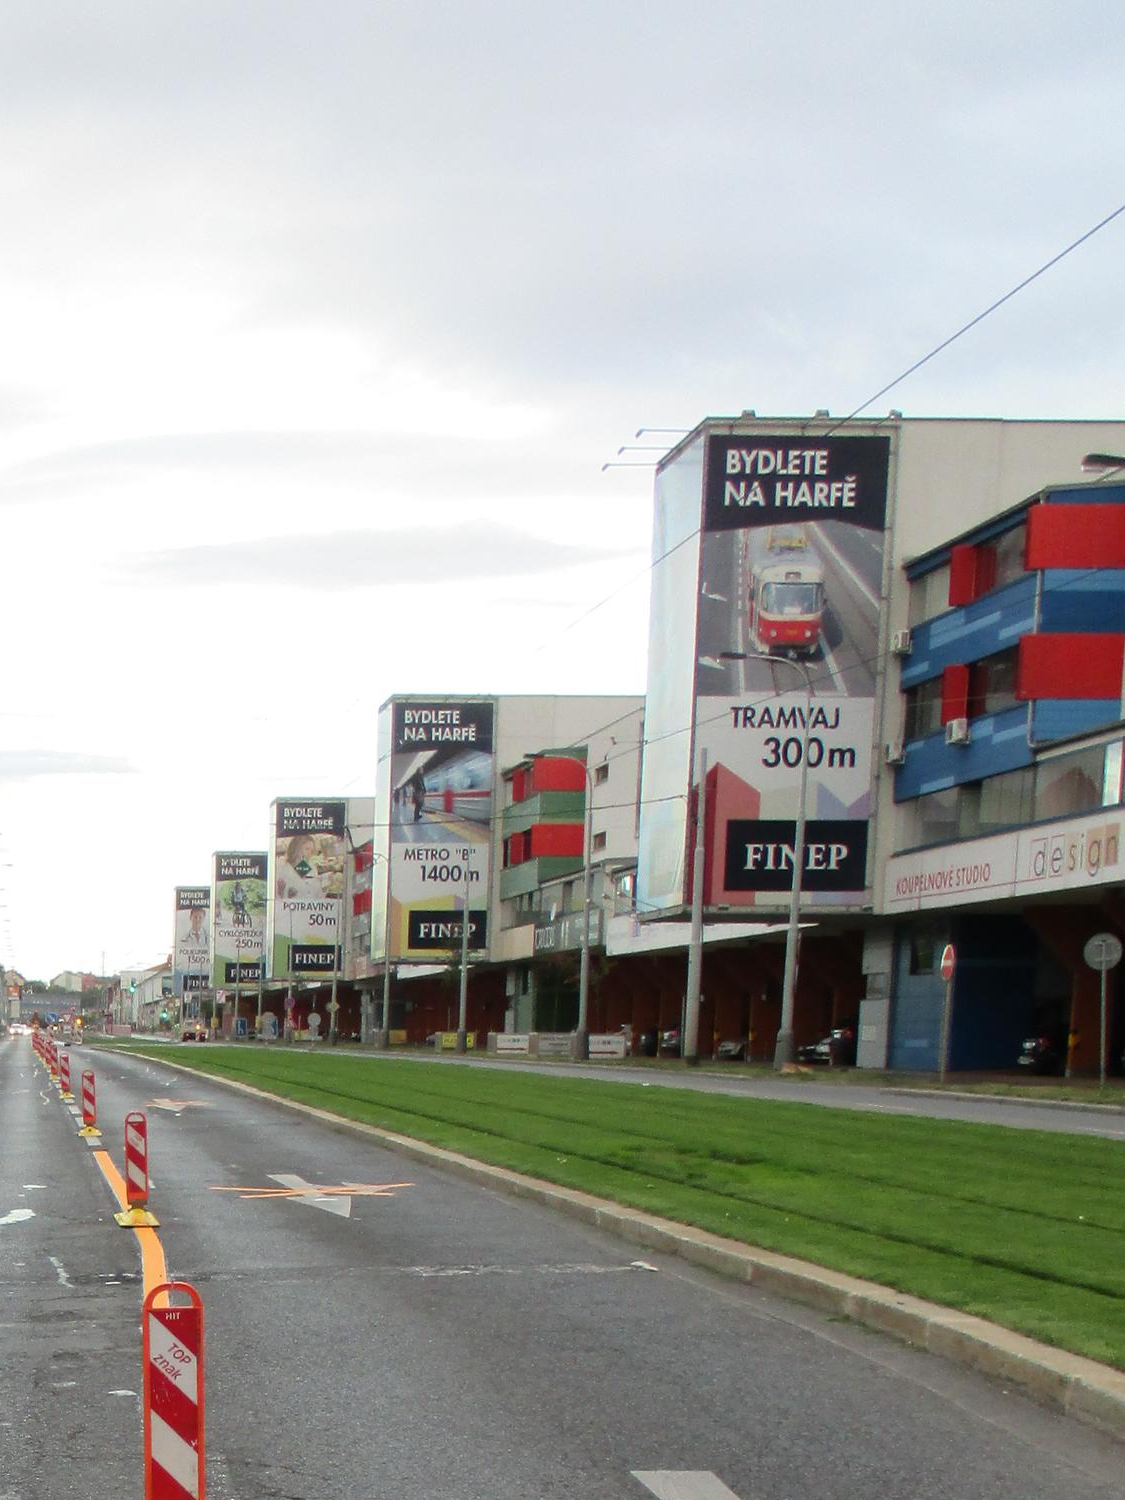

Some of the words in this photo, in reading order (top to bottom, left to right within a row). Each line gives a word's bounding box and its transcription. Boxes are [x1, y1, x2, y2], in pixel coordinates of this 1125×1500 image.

[725, 448, 829, 476] BYDLETE
[723, 479, 766, 508] NA
[774, 474, 858, 509] HARFĚ
[404, 709, 461, 725] BYDLETE
[730, 705, 842, 730] TRAMVAJ
[403, 726, 428, 742] NA
[431, 723, 477, 742] HARFĚ
[761, 735, 825, 769] 300
[827, 746, 857, 769] m
[283, 807, 323, 818] BYDLETE
[283, 819, 300, 830] NA
[302, 817, 334, 830] HARFĚ
[403, 848, 451, 862] METRO
[743, 842, 849, 871] FINEP
[1032, 834, 1119, 877] design
[221, 867, 234, 876] NA
[419, 864, 463, 883] 1400
[463, 870, 480, 883] m
[895, 864, 954, 896] KOUPELNOVÉ
[955, 862, 992, 887] STUDIO
[283, 902, 335, 912] POTRAVINY
[308, 914, 325, 926] 50
[325, 917, 336, 926] m
[235, 939, 253, 949] 250
[294, 953, 335, 965] FINEP
[230, 968, 260, 978] FNEP
[165, 1312, 181, 1320] HIT
[167, 1342, 192, 1364] TOP
[153, 1354, 182, 1380] znak
